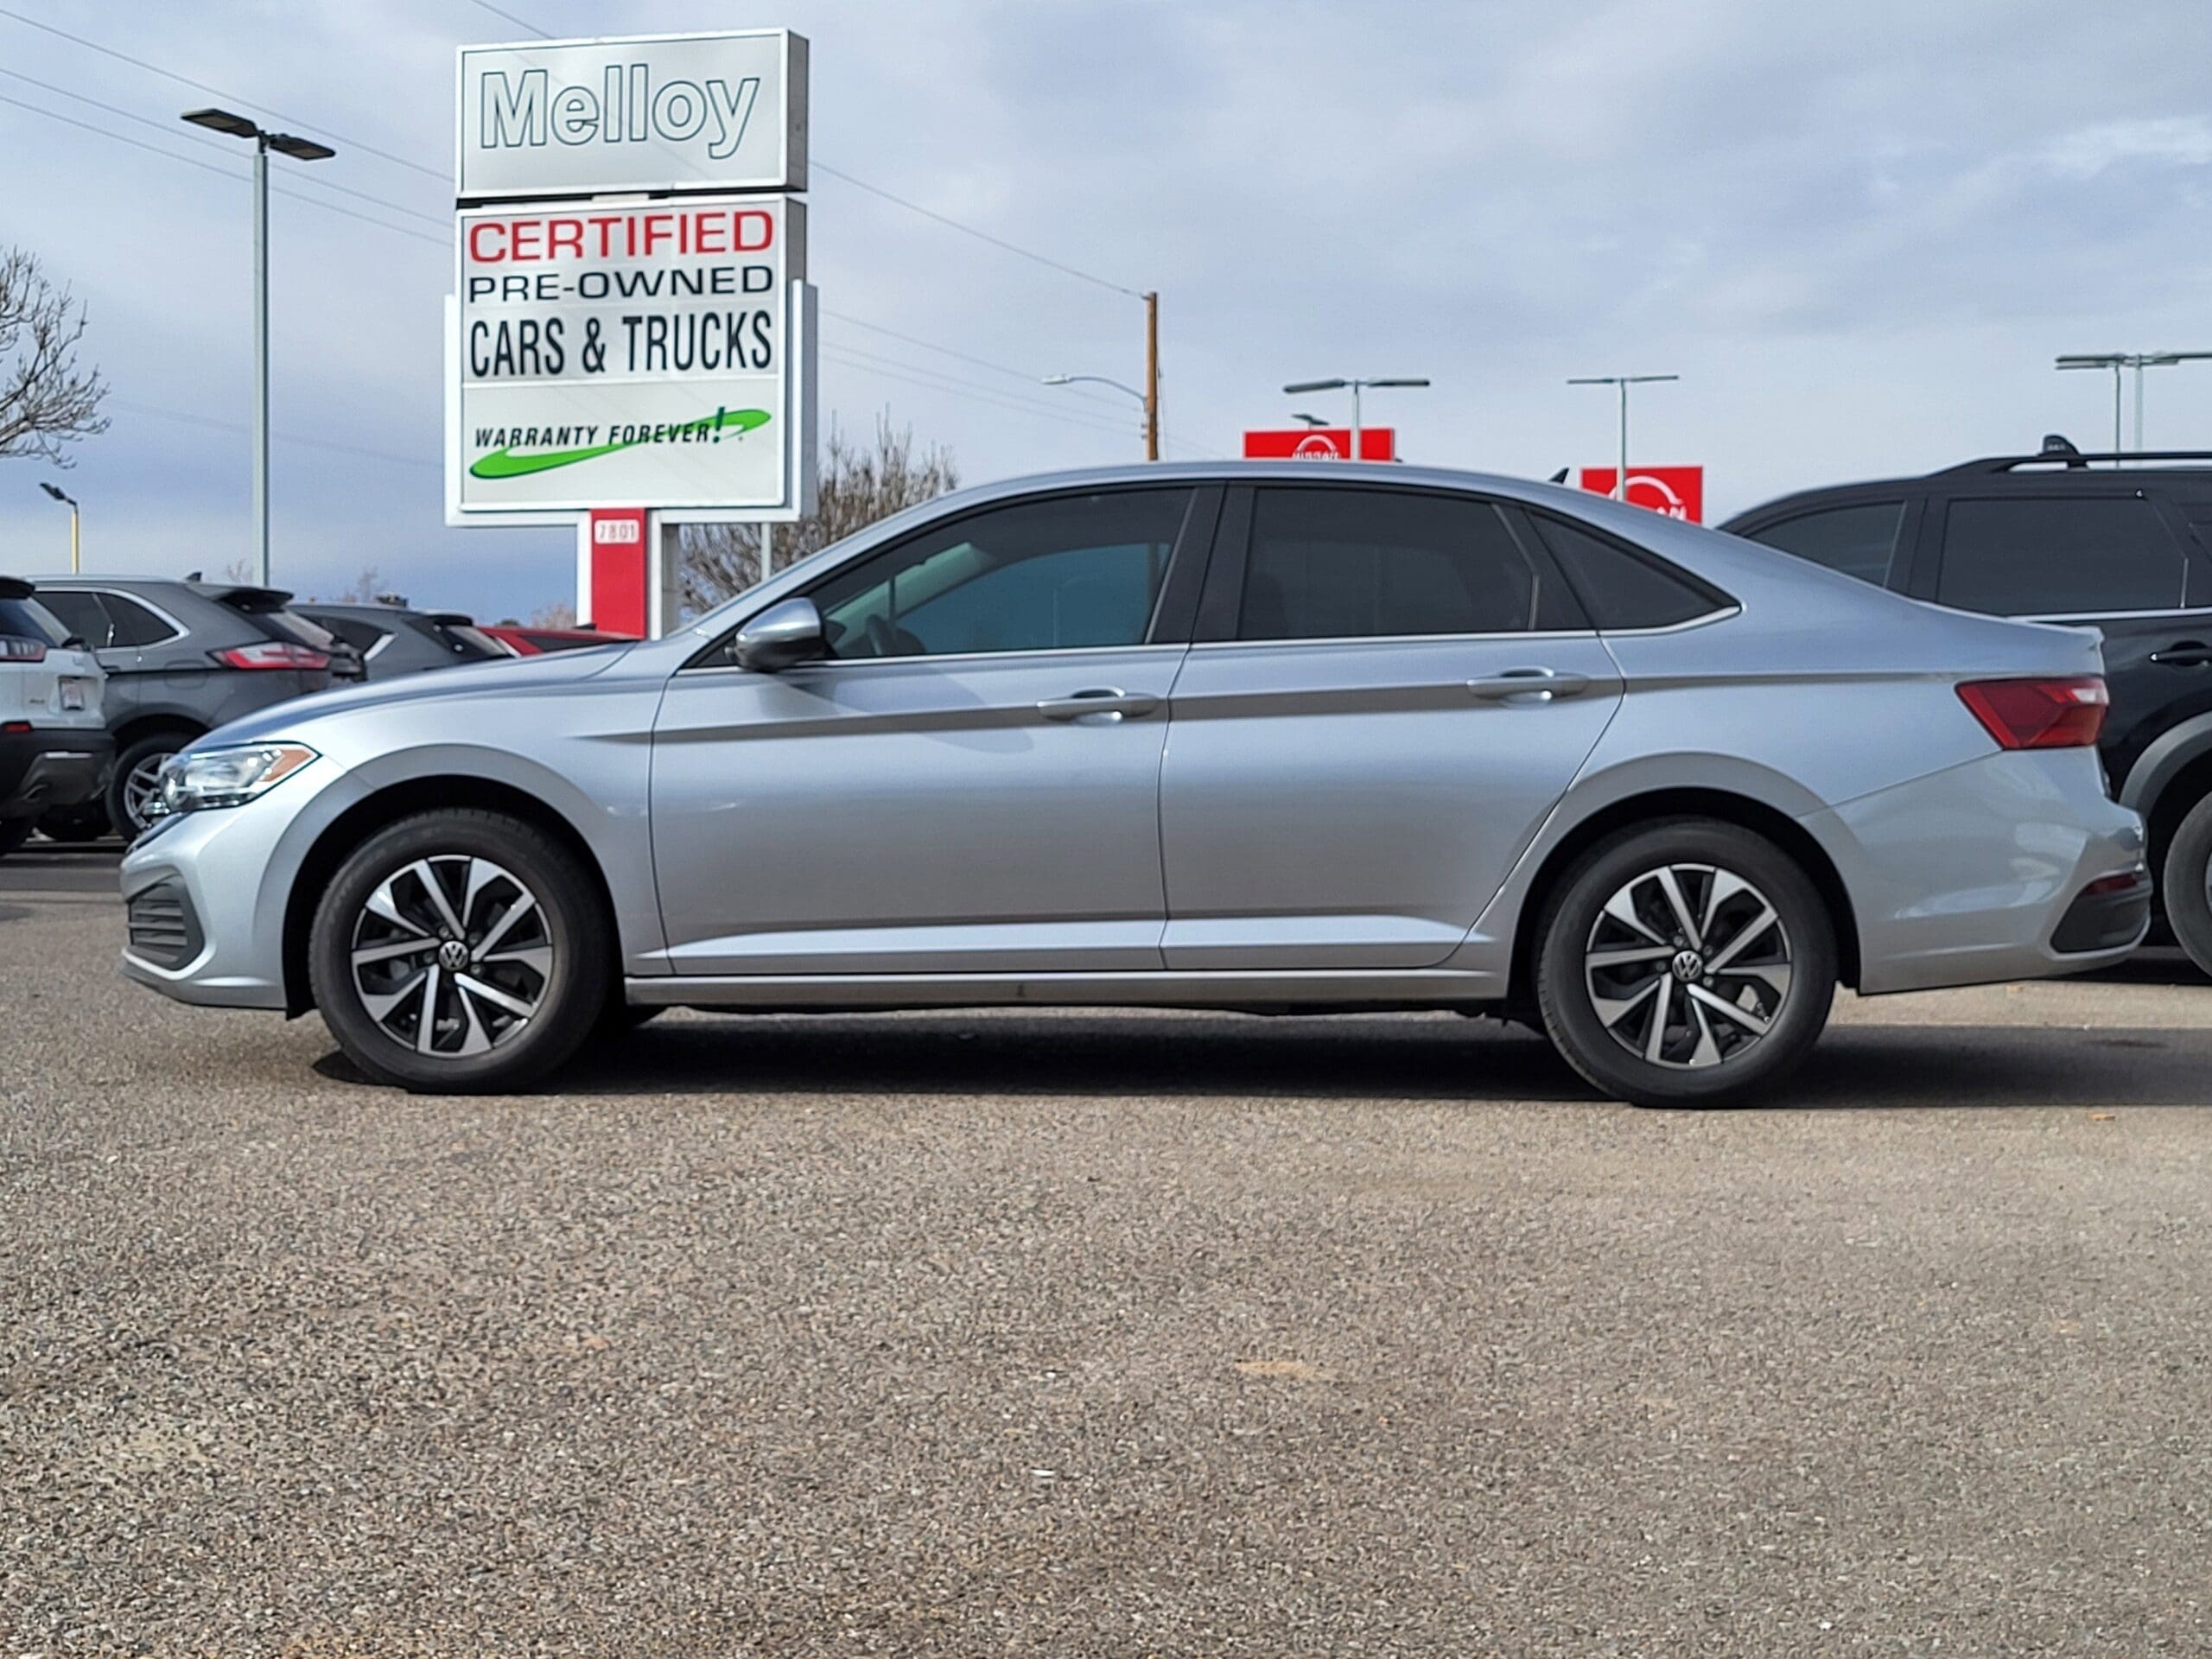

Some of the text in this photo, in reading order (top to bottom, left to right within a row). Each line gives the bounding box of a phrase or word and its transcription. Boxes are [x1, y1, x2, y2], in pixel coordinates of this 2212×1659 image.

[480, 63, 760, 160] Melloy
[469, 210, 774, 263] CERTIFIED
[469, 265, 773, 303] PRE-OWNED
[470, 309, 772, 377] CARS & TRUCKS
[474, 405, 726, 448] WARRANTY FOREVER!
[599, 524, 636, 540] 7801
